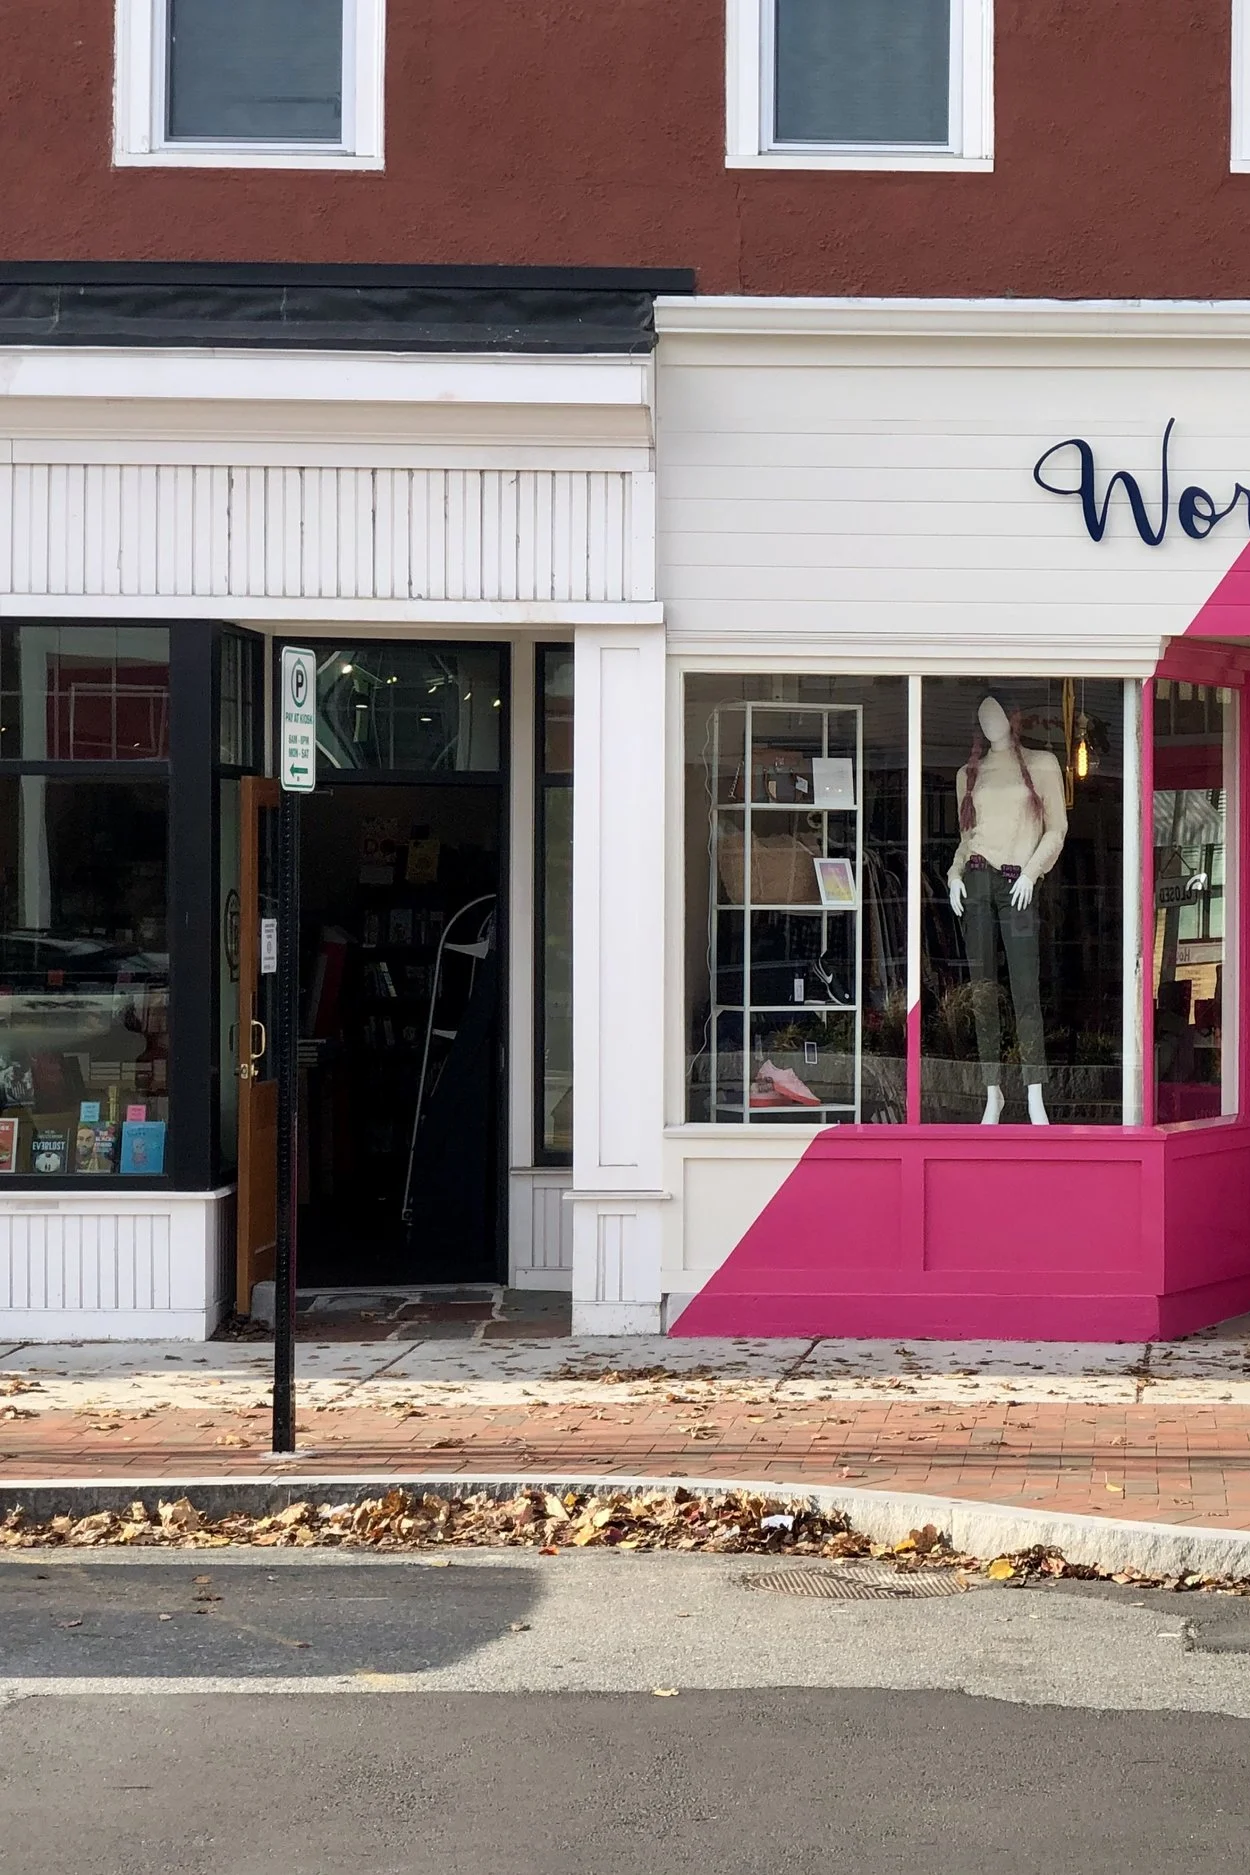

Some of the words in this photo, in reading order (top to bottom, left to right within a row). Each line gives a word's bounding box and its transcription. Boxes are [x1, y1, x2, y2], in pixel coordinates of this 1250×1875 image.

[296, 669, 304, 698] P
[286, 711, 294, 724] PAY
[294, 713, 300, 724] AT
[300, 714, 313, 725] KIOSK
[288, 748, 298, 758] MON
[301, 748, 309, 760] SAT
